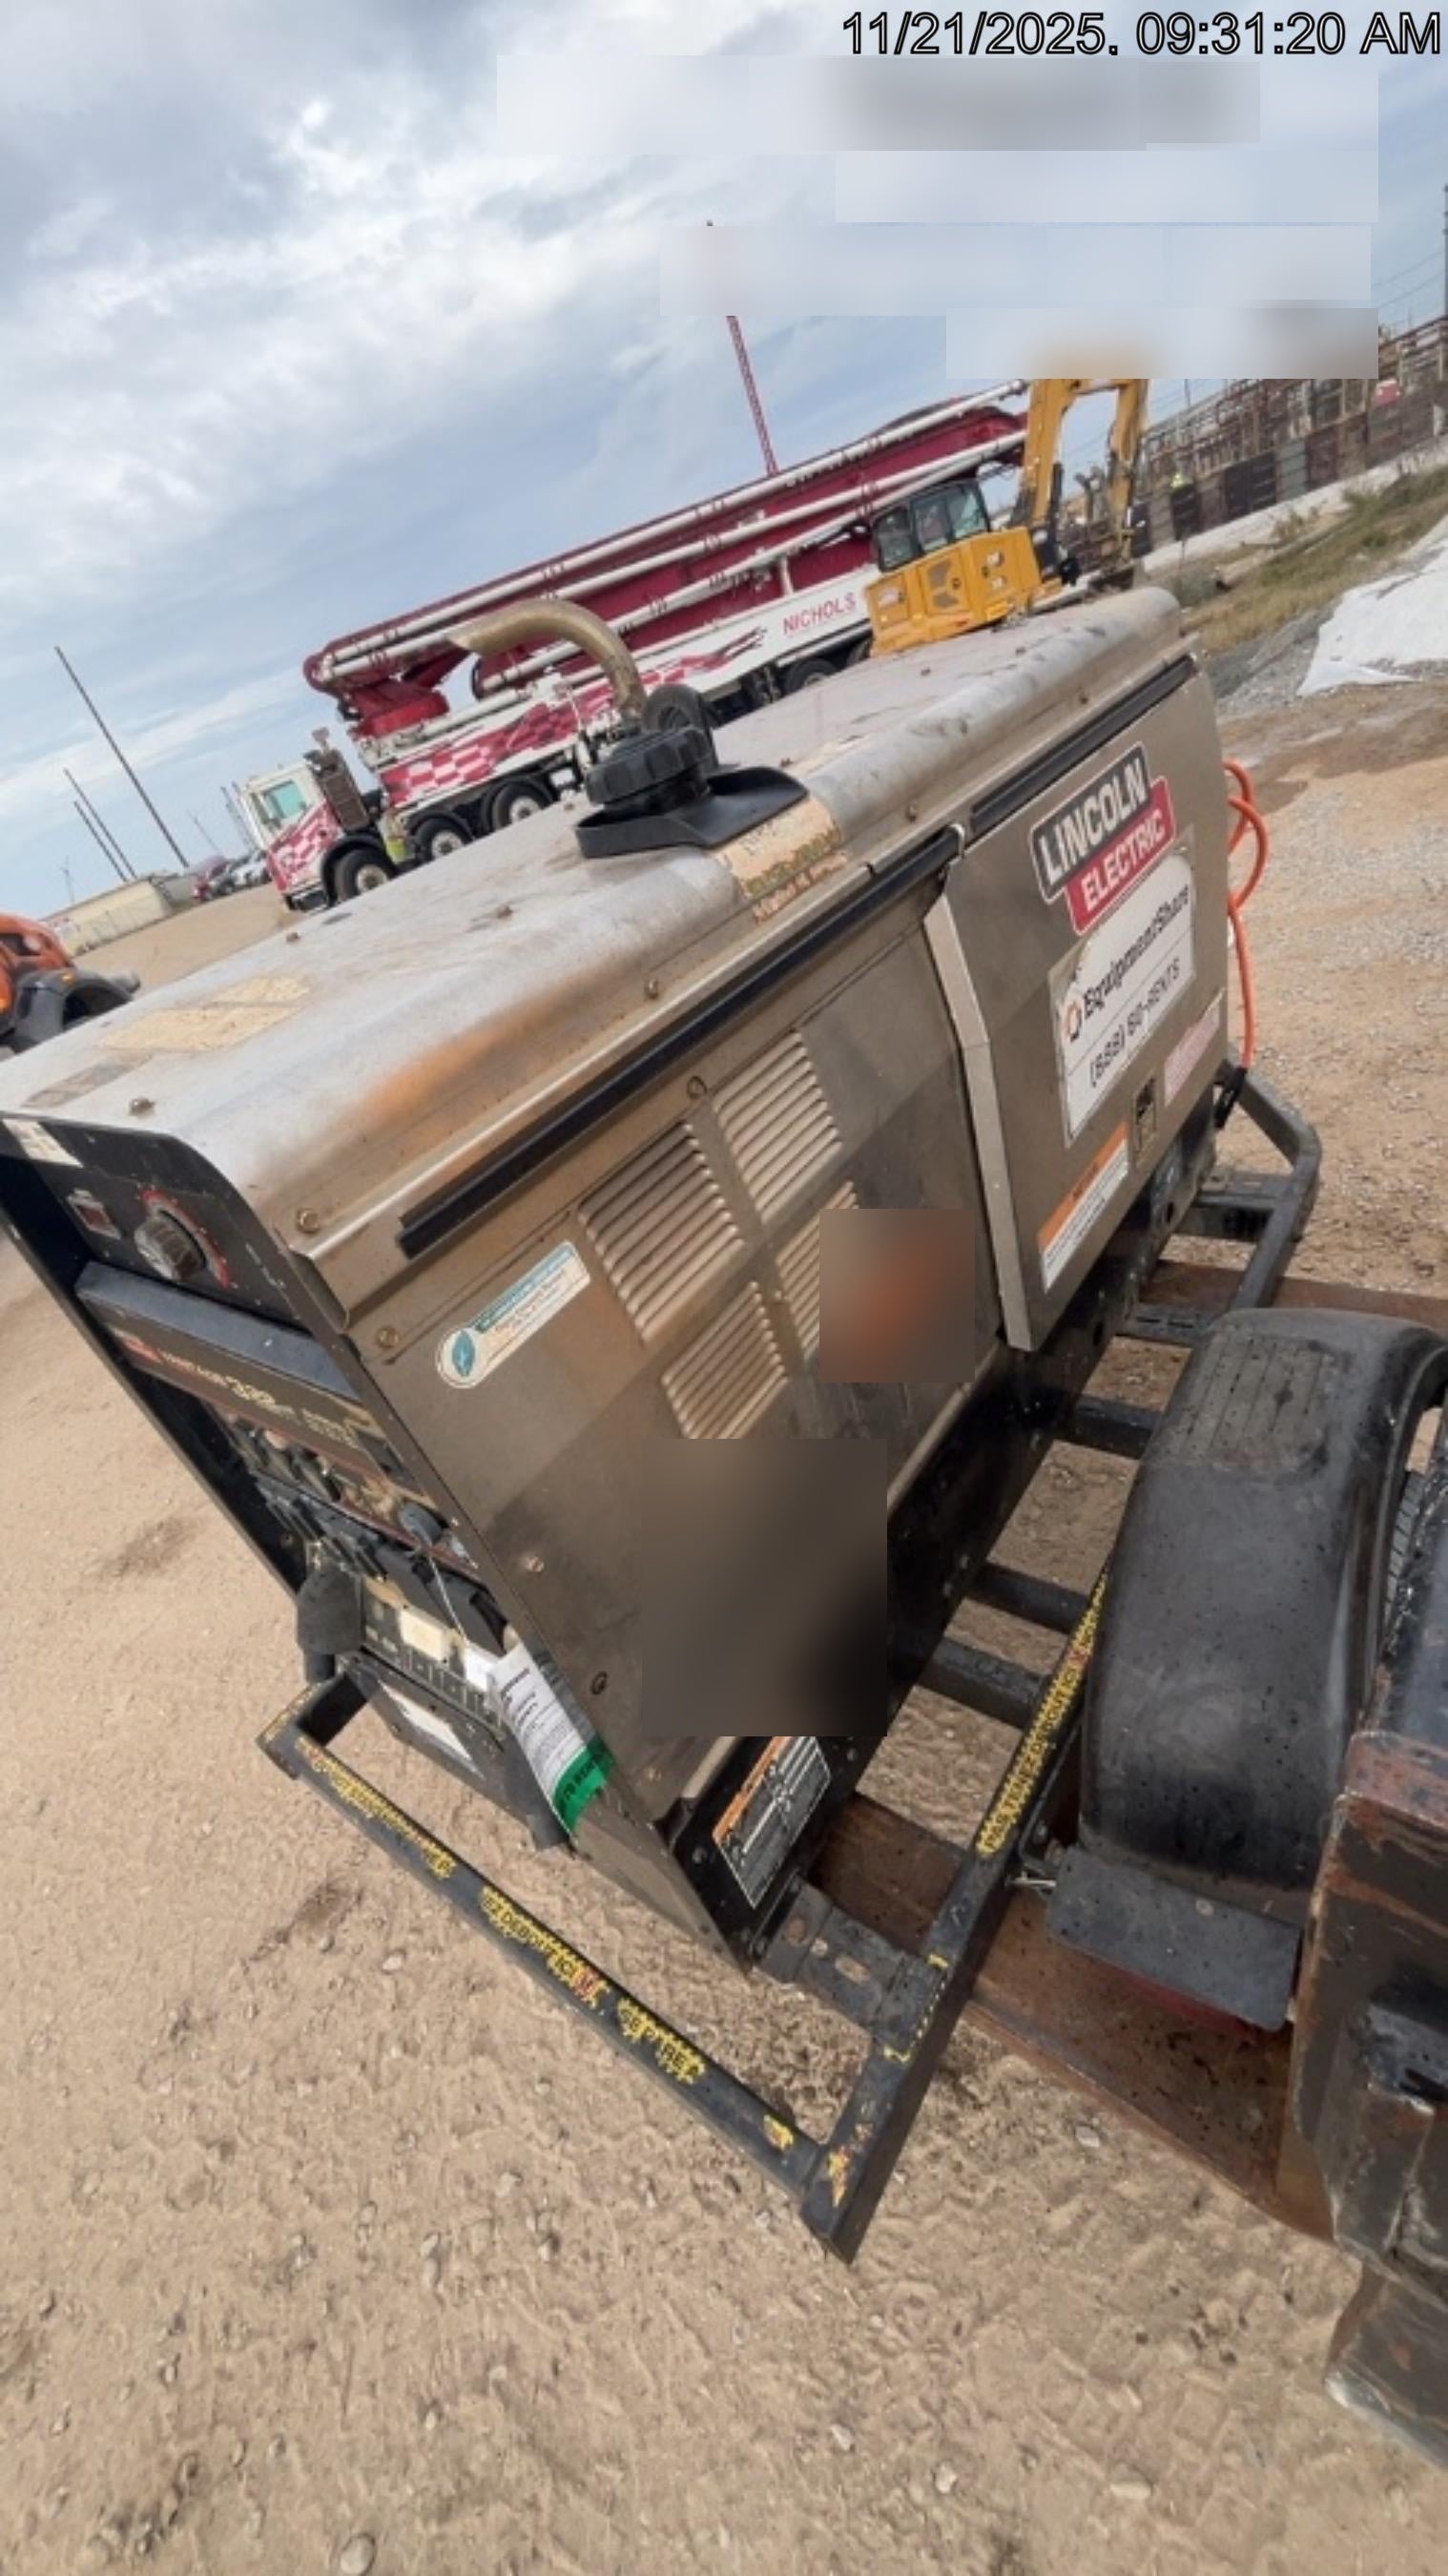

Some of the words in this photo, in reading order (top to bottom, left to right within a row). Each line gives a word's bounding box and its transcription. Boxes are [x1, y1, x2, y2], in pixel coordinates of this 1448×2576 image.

[783, 592, 857, 634] NICHOLS
[1040, 758, 1148, 886] LINCOLN
[1081, 809, 1166, 911] ELECTRIC
[1084, 884, 1189, 1020] EquipmentShare
